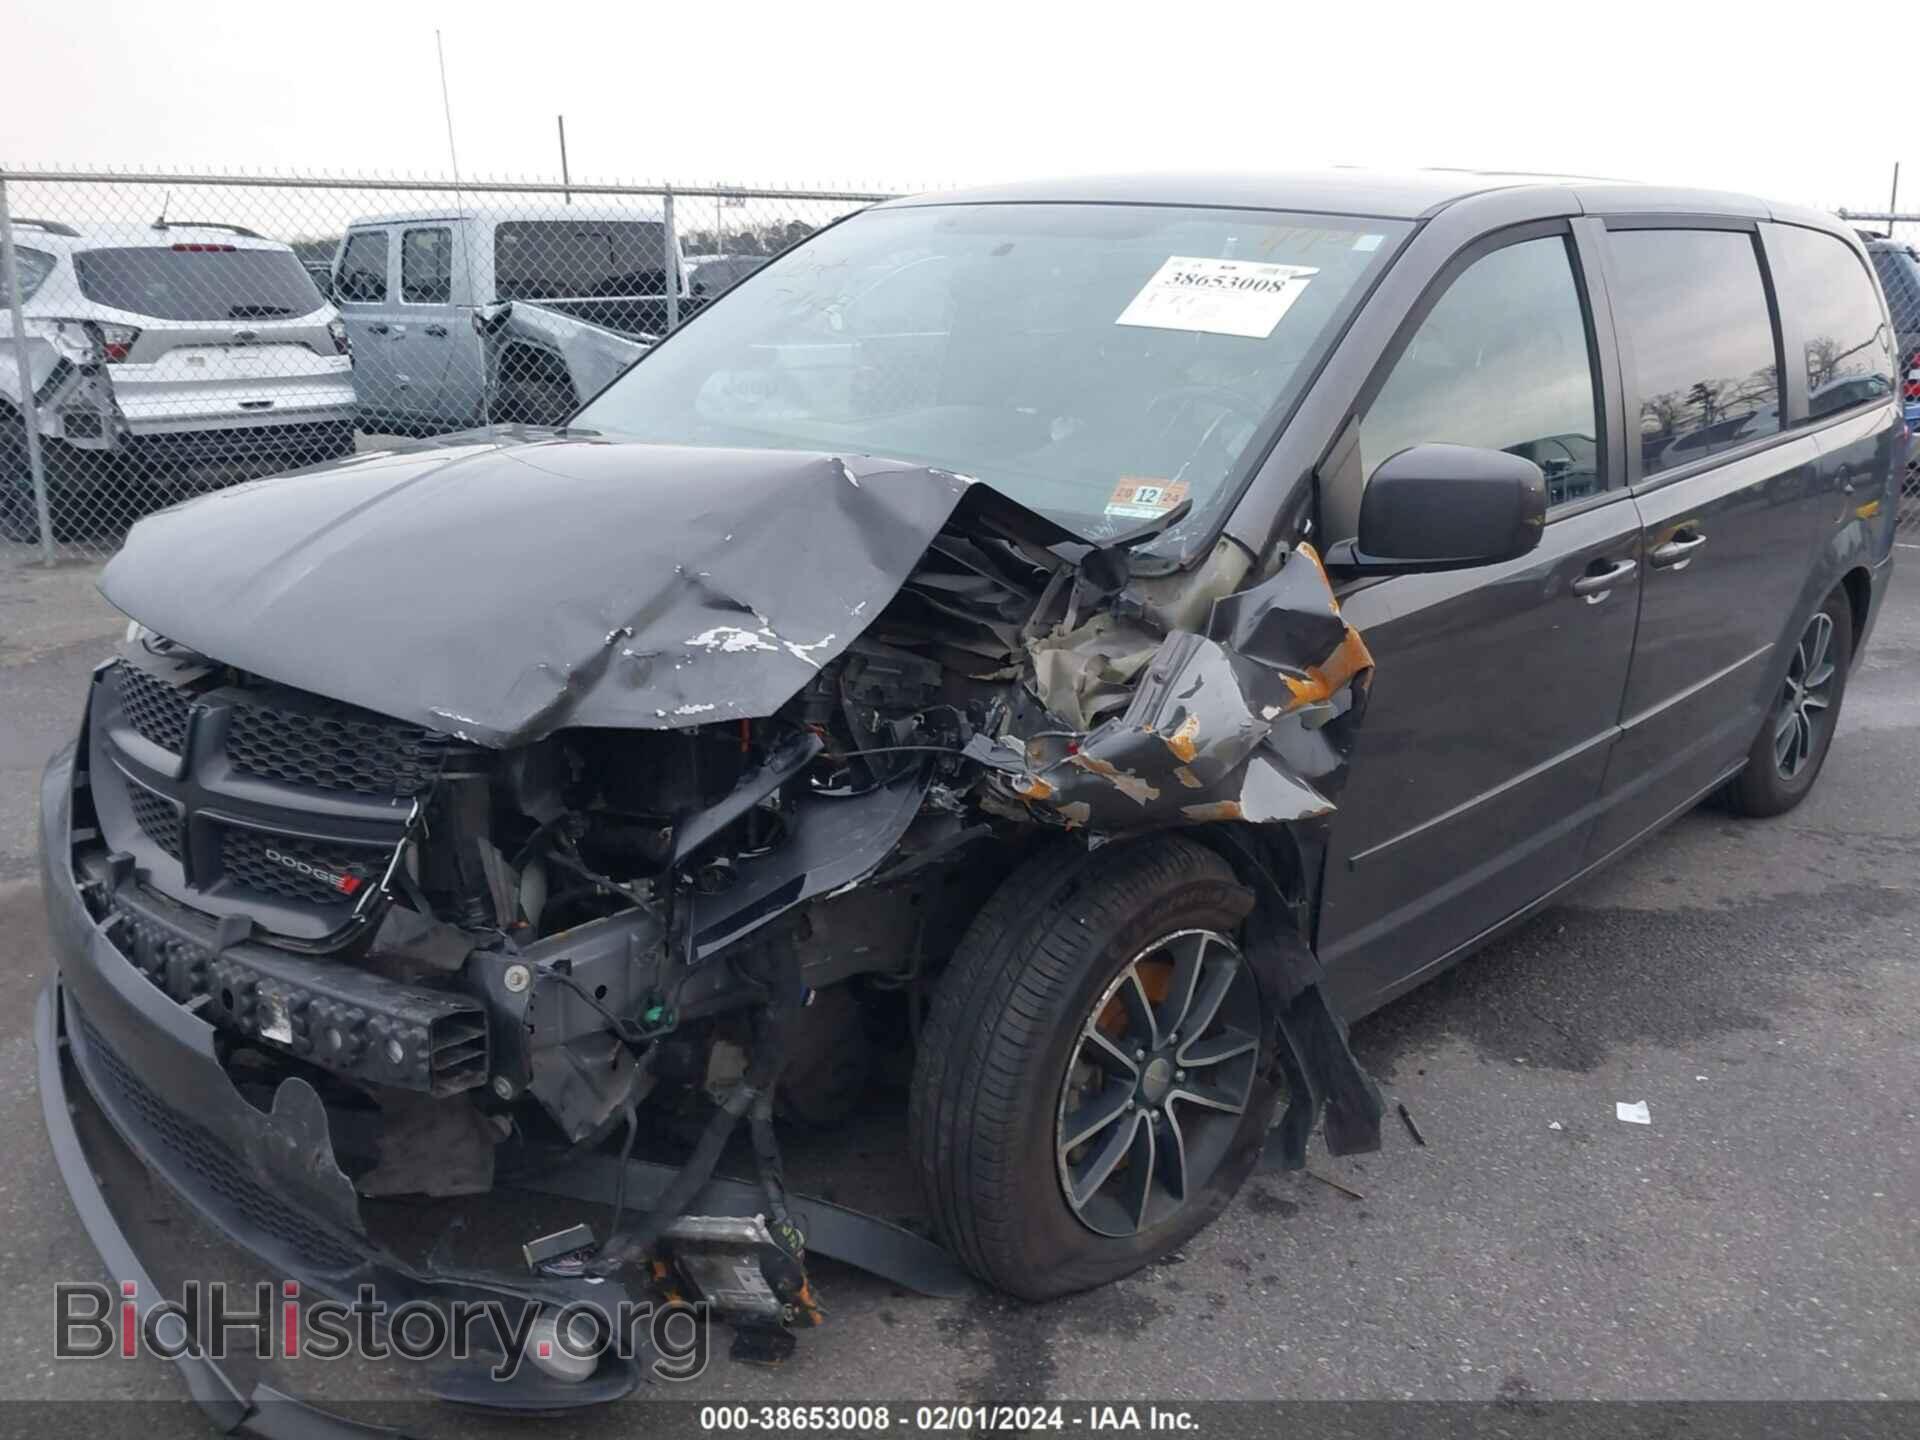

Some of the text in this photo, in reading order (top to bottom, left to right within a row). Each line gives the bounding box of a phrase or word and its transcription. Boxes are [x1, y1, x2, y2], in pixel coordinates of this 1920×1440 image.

[1164, 271, 1286, 293] 38653008
[1136, 488, 1158, 503] 12
[265, 848, 345, 888] DODGE
